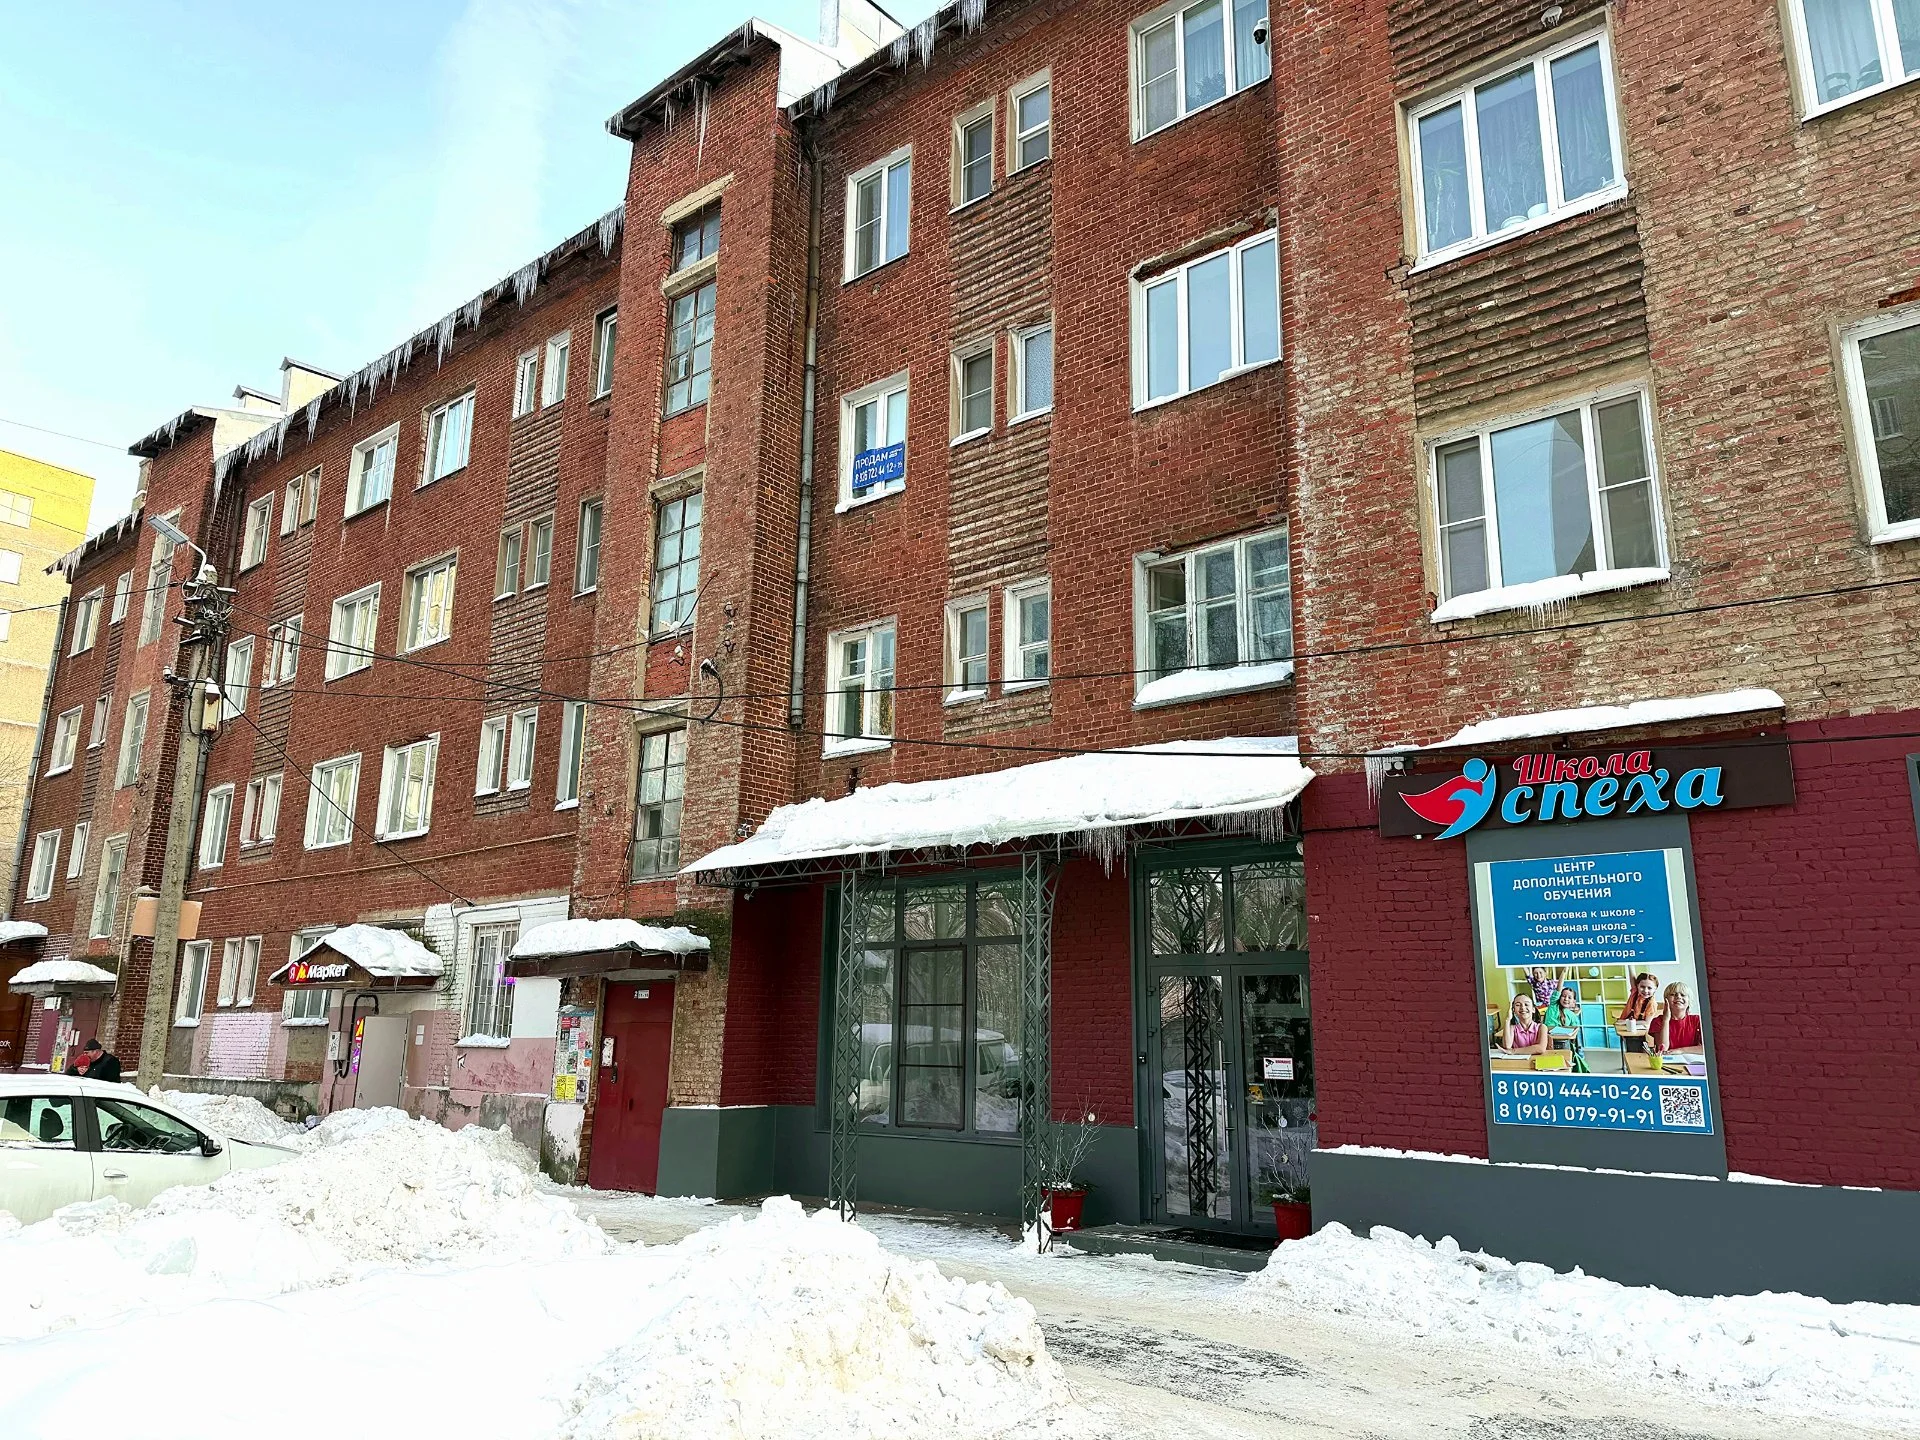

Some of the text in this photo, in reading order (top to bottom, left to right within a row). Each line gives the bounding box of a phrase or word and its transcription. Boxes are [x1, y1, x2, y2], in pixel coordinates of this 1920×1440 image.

[856, 452, 888, 470] ПРОДАМ
[1513, 750, 1653, 786] Школа
[1555, 861, 1595, 874] ЦЕНТР
[1513, 871, 1641, 890] ДОПОЛНИТЕЛЬНОГО
[1544, 888, 1611, 900] ОБУЧЕНИЯ
[1526, 912, 1587, 921] Подготовка
[1601, 909, 1635, 917] школе
[1536, 924, 1588, 932] Семейная
[1523, 938, 1584, 947] Подготовка
[1597, 934, 1644, 944] ОГЭ/ЕГЭ
[1533, 951, 1568, 960] Услуги
[1572, 950, 1635, 959] репетитора
[307, 964, 348, 980] Маркет
[1498, 1080, 1652, 1100] 8 (910) 444-10-26
[1500, 1103, 1654, 1125] 8 (916) 079-91-91
